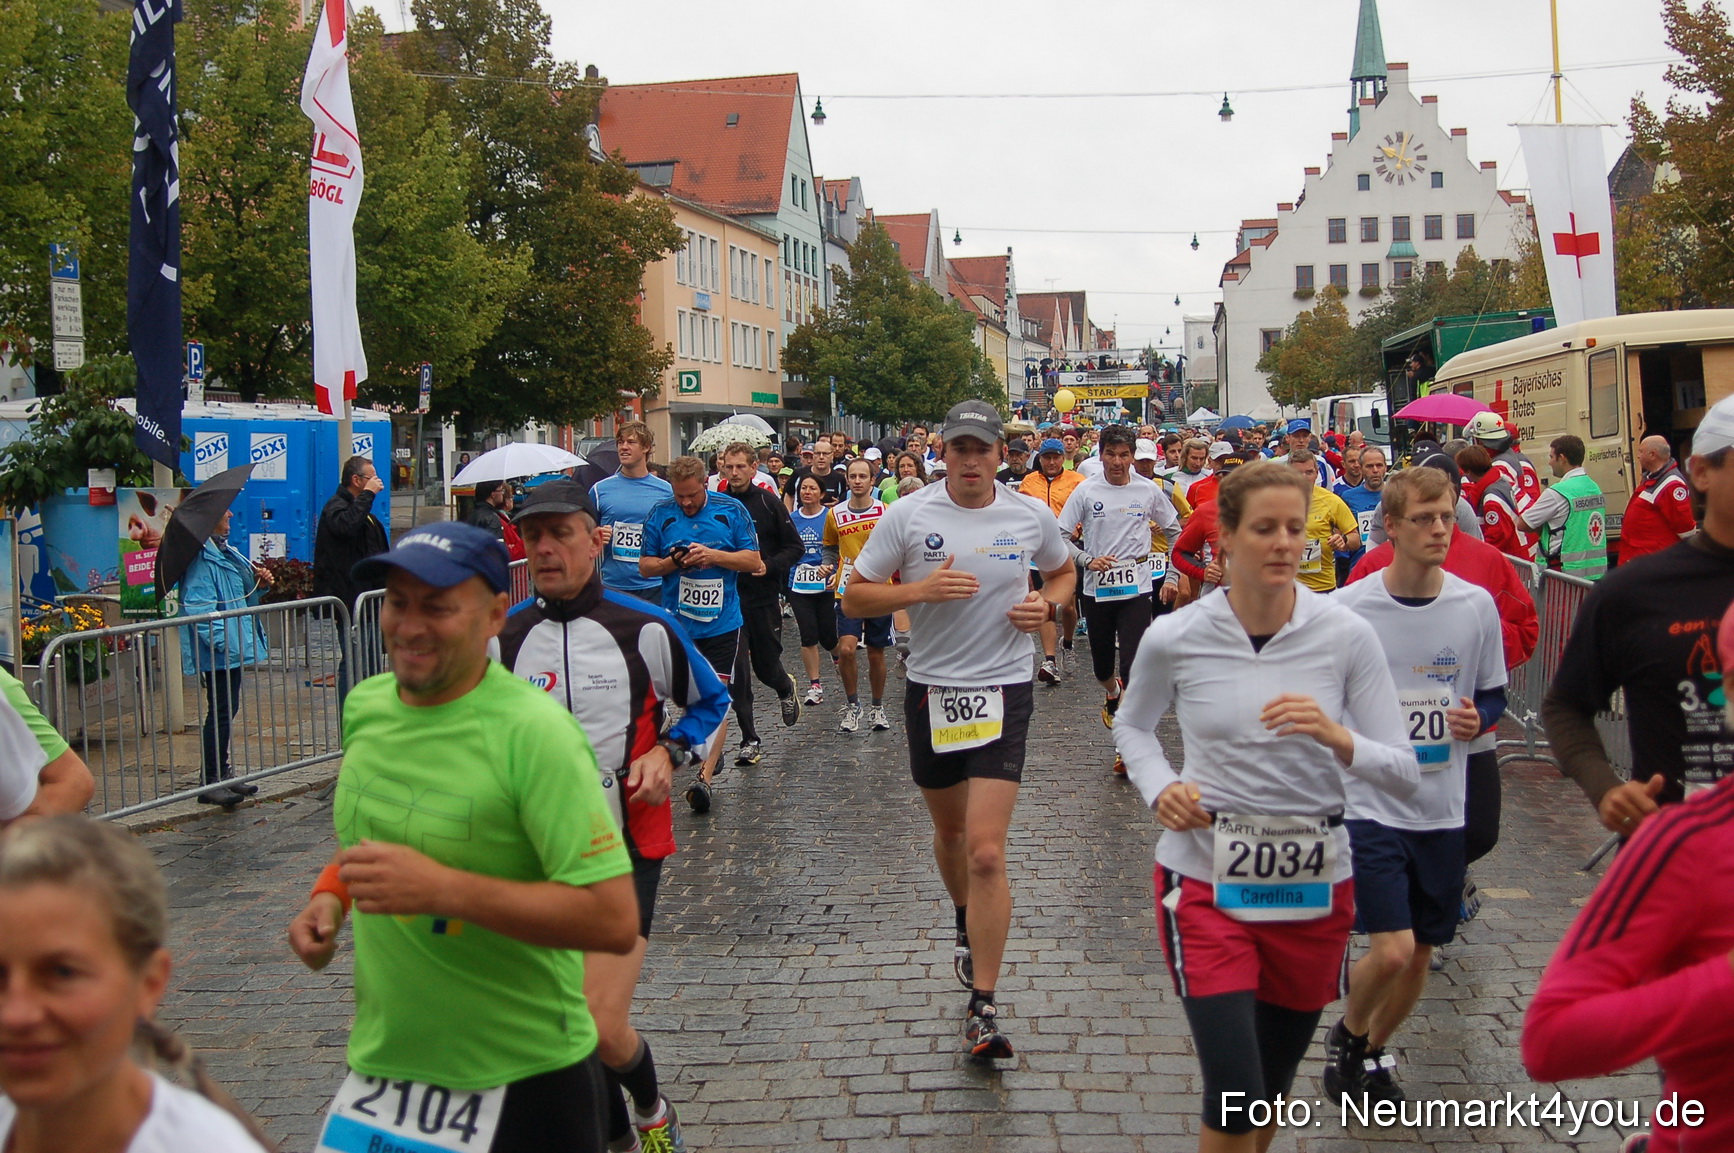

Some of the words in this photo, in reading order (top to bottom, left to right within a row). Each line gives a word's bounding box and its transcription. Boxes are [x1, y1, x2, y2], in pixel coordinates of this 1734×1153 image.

[310, 177, 344, 205] BÖGL
[681, 373, 698, 390] D
[1512, 369, 1562, 398] Bayerisches
[1087, 388, 1118, 397] START
[1512, 400, 1536, 418] Rotes
[1589, 449, 1618, 463] Bayerisches
[839, 526, 859, 538] MAX
[862, 521, 876, 531] BÖ
[1362, 520, 1370, 532] 2
[616, 531, 642, 548] 253
[143, 550, 158, 559] SEPT
[129, 562, 151, 573] BEIDE
[1149, 559, 1162, 570] 08
[681, 580, 694, 588] PARTL
[1097, 569, 1134, 586] 2416
[683, 588, 720, 608] 2992
[582, 683, 610, 691] nürnberg
[943, 695, 988, 723] 582
[1399, 698, 1437, 707] eumarkt
[939, 725, 979, 743] Michael
[1218, 822, 1259, 836] PARTL
[1262, 825, 1318, 836] Neumarkt
[1226, 840, 1325, 878] 2034
[1241, 888, 1304, 905] Carolina
[351, 1075, 483, 1144] 2104
